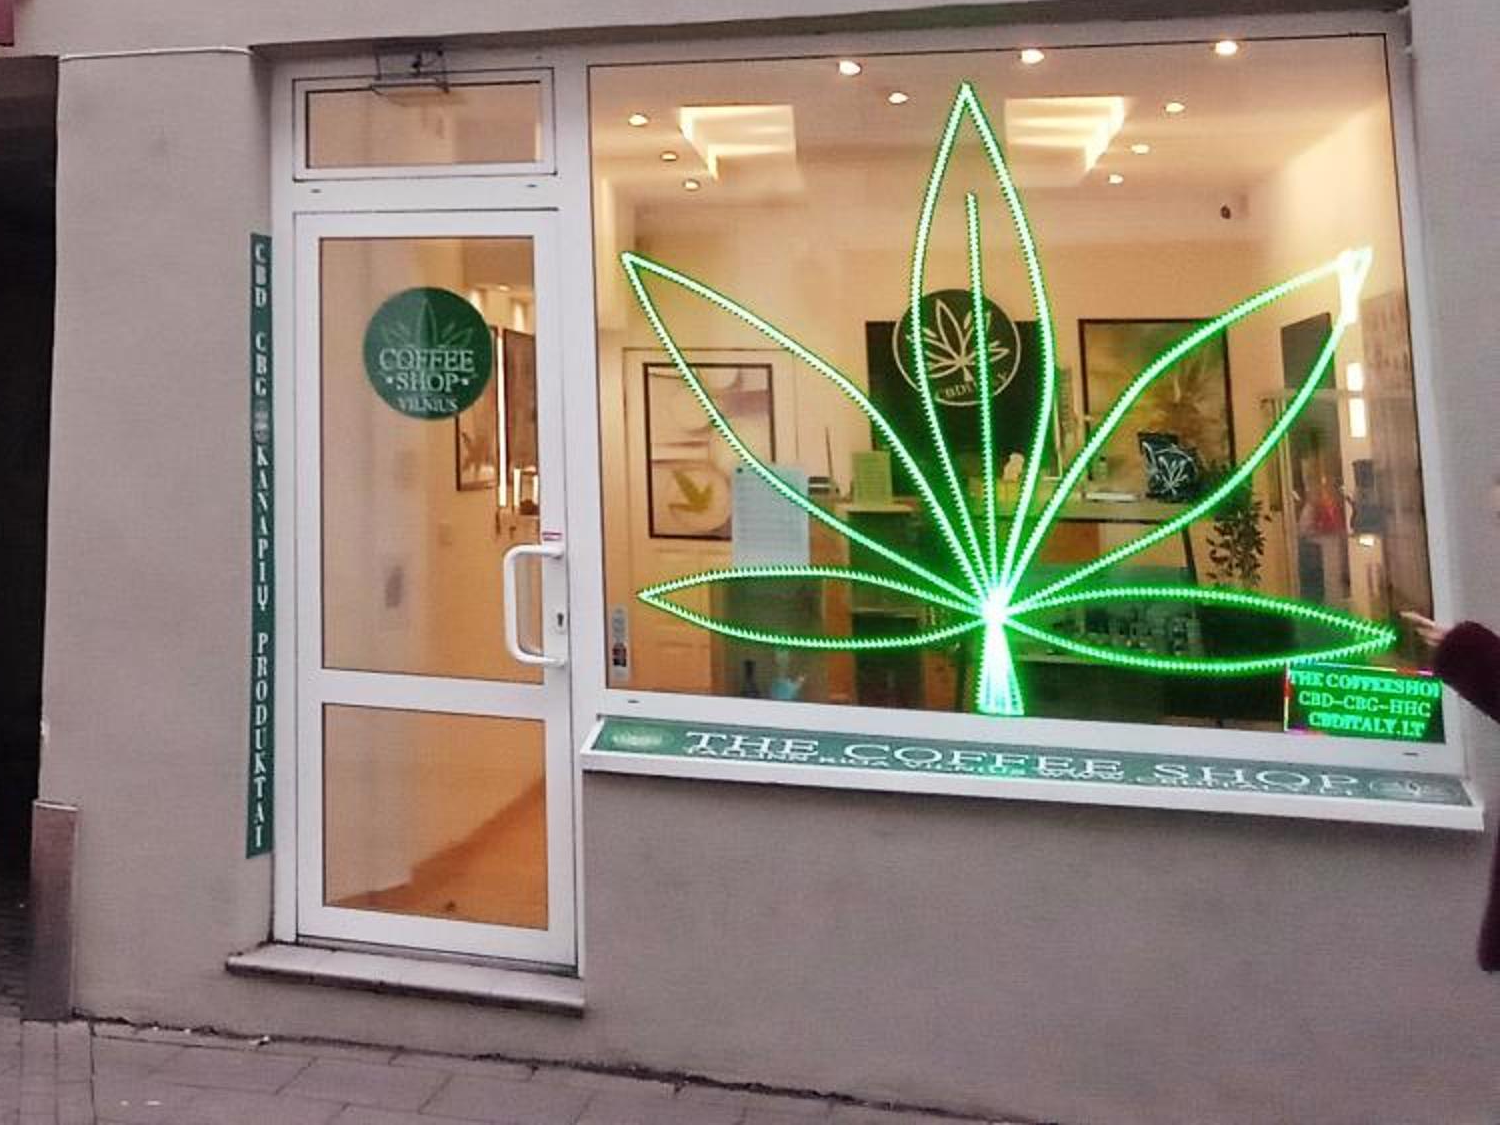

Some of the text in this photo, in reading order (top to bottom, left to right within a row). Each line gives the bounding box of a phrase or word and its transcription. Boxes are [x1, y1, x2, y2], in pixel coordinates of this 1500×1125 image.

[379, 346, 476, 373] COFFEE
[395, 372, 460, 393] SHOP
[1289, 670, 1324, 687] THE
[1308, 711, 1426, 738] CBDITALY.LT
[685, 731, 819, 757] THE
[843, 742, 1124, 774] COFFEE
[1153, 762, 1359, 791] SHOP
